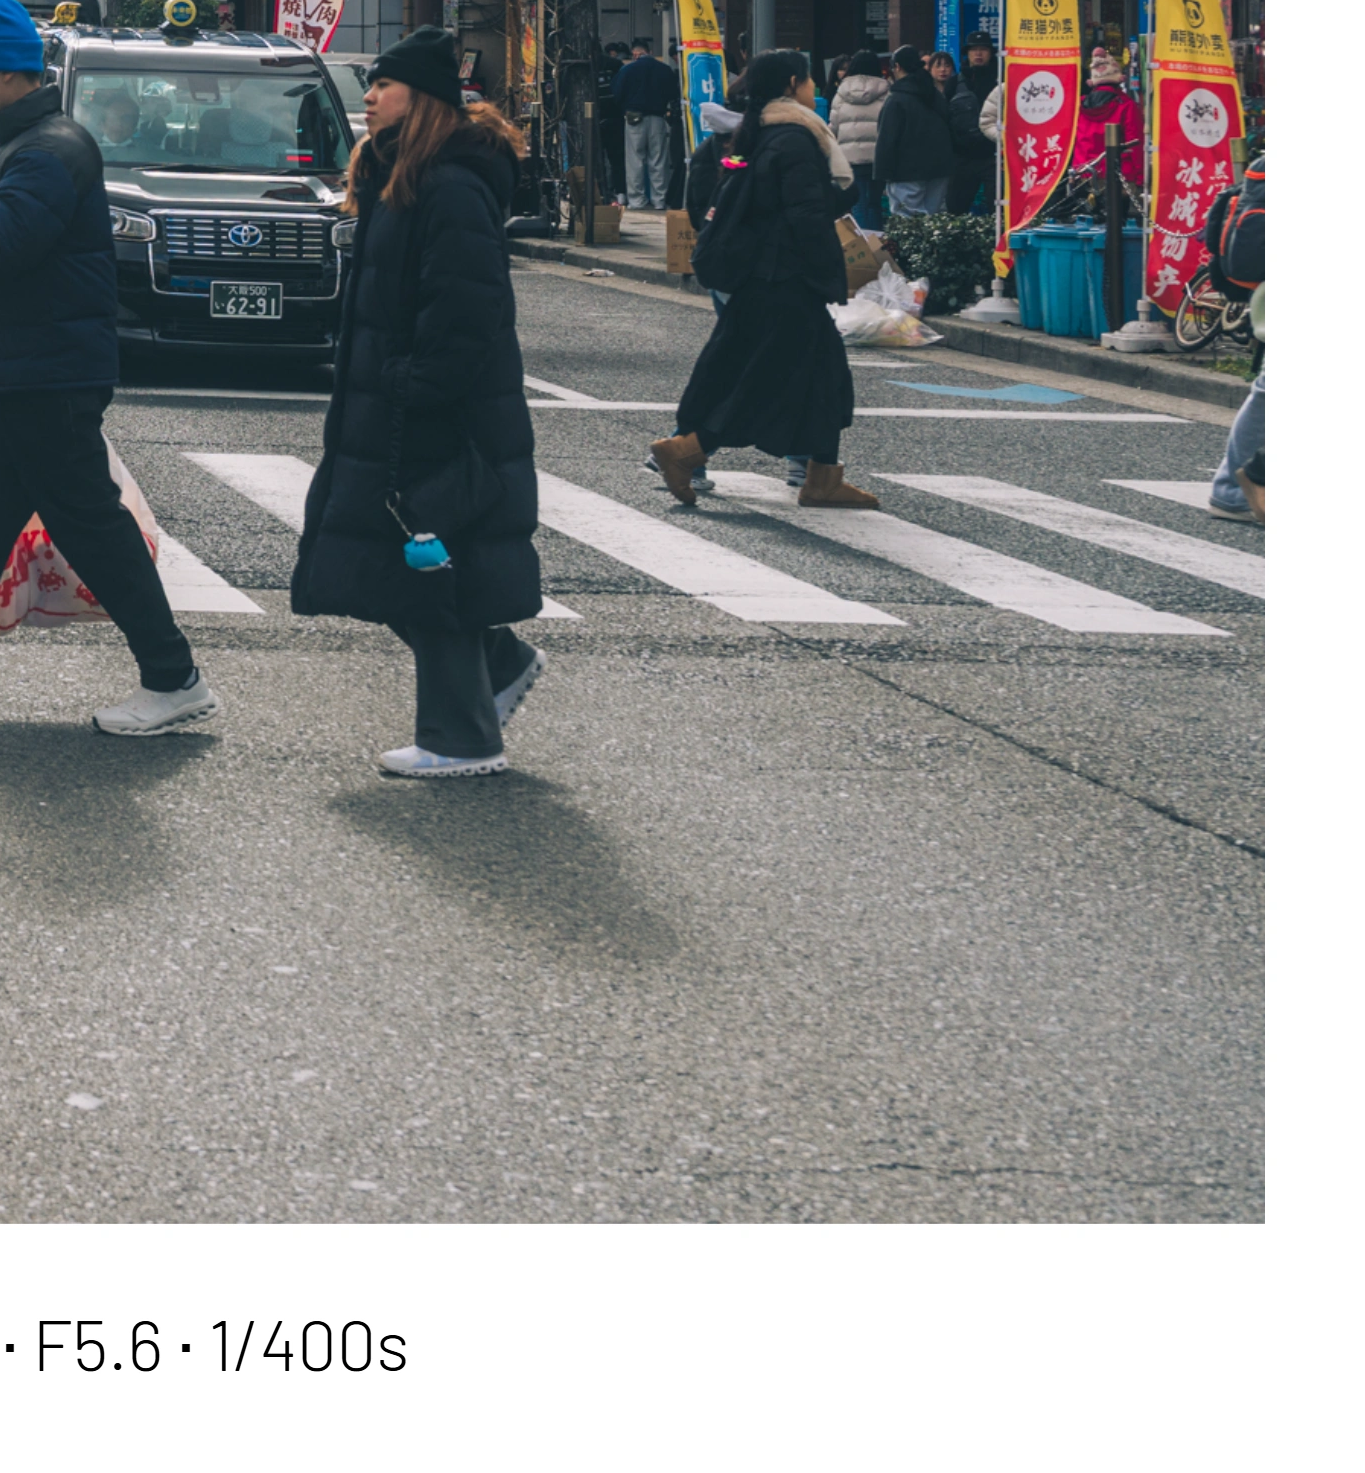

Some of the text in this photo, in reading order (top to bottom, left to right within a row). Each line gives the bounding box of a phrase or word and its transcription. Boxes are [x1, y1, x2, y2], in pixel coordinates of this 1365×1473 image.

[1017, 17, 1074, 36] 熊猫外卖
[1169, 28, 1225, 52] 熊猫外卖
[226, 296, 276, 316] 62-91
